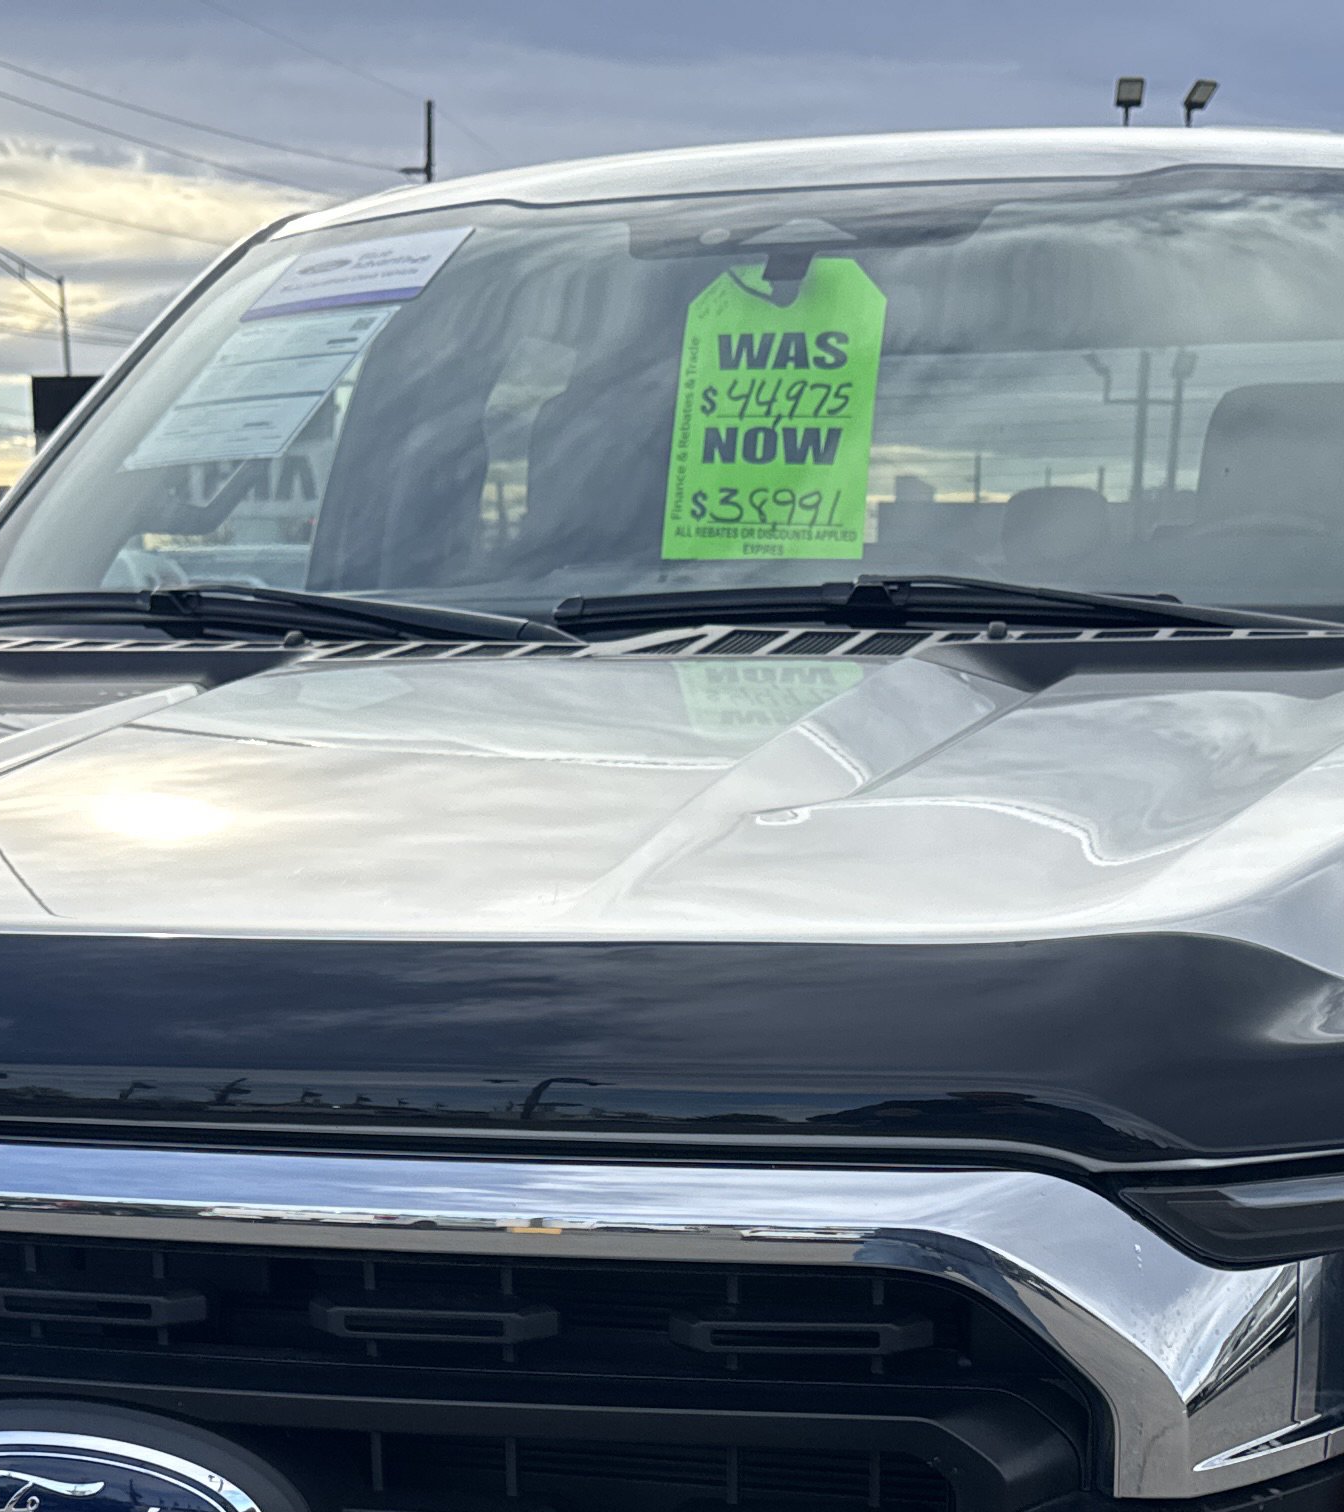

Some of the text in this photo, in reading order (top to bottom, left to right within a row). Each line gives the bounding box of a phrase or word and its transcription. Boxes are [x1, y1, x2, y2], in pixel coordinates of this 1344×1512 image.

[686, 336, 700, 376] Trade
[717, 331, 849, 370] WAS
[679, 392, 695, 449] Rebates
[702, 427, 842, 465] NOW
[671, 464, 687, 520] Finance
[674, 527, 857, 543] ALL REBATES OR DISCOUNTS APPLIED
[743, 543, 784, 555] EXPIRES
